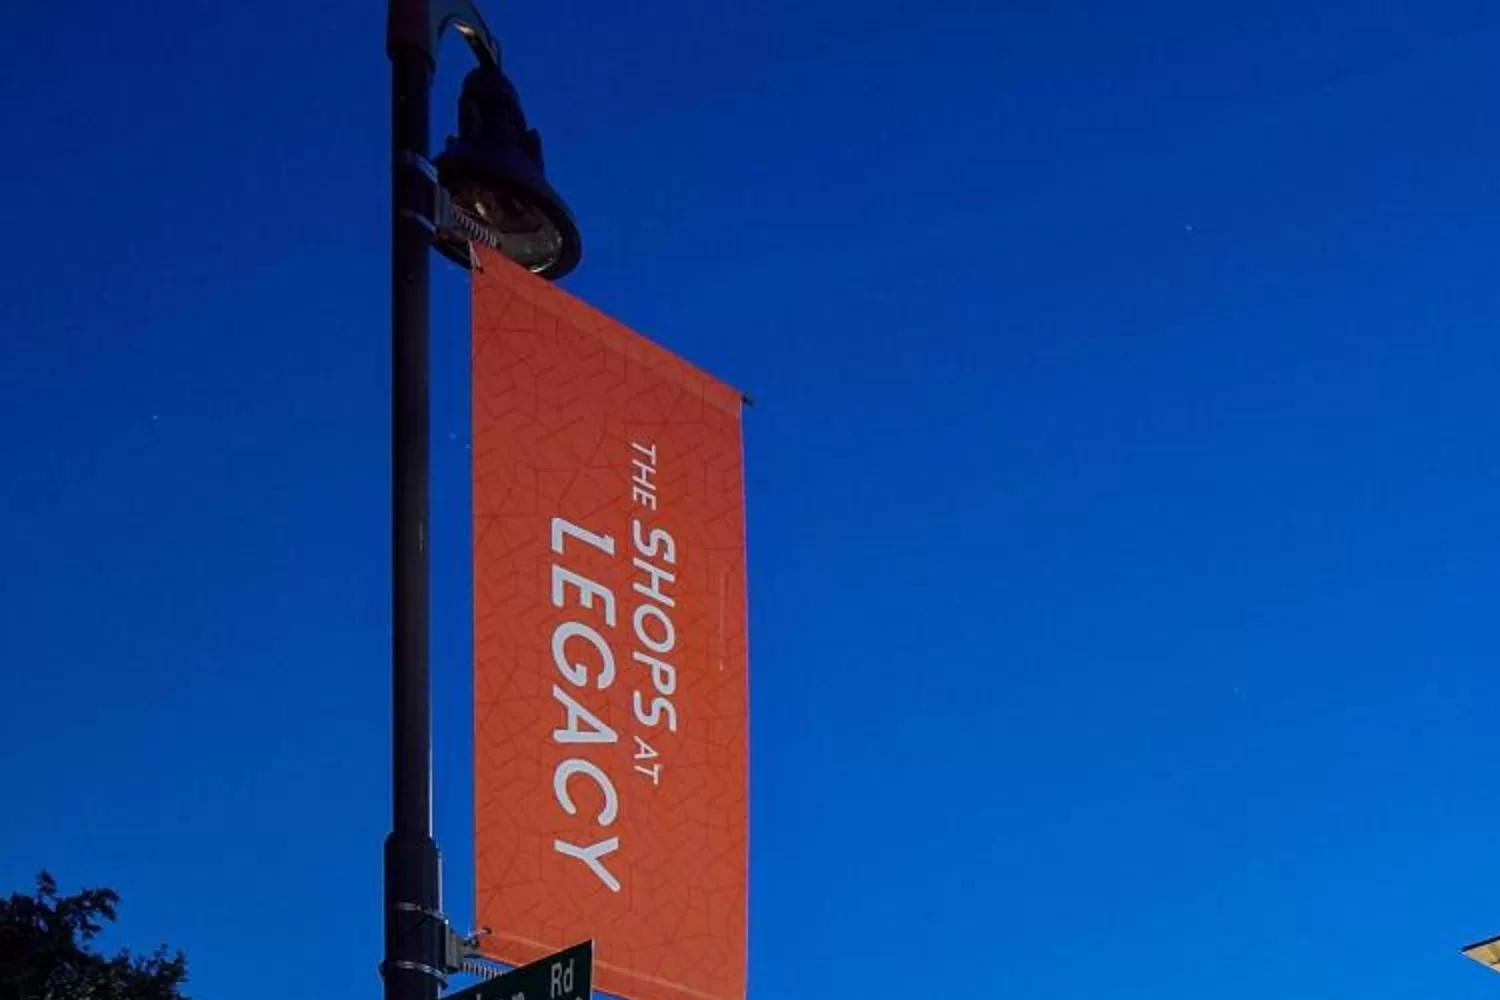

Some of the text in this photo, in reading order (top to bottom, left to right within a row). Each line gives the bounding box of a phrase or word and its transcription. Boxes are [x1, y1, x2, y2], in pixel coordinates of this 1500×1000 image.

[551, 516, 622, 893] LEGACY
[632, 442, 677, 785] THE SHOPS AT
[551, 957, 575, 999] Rd
